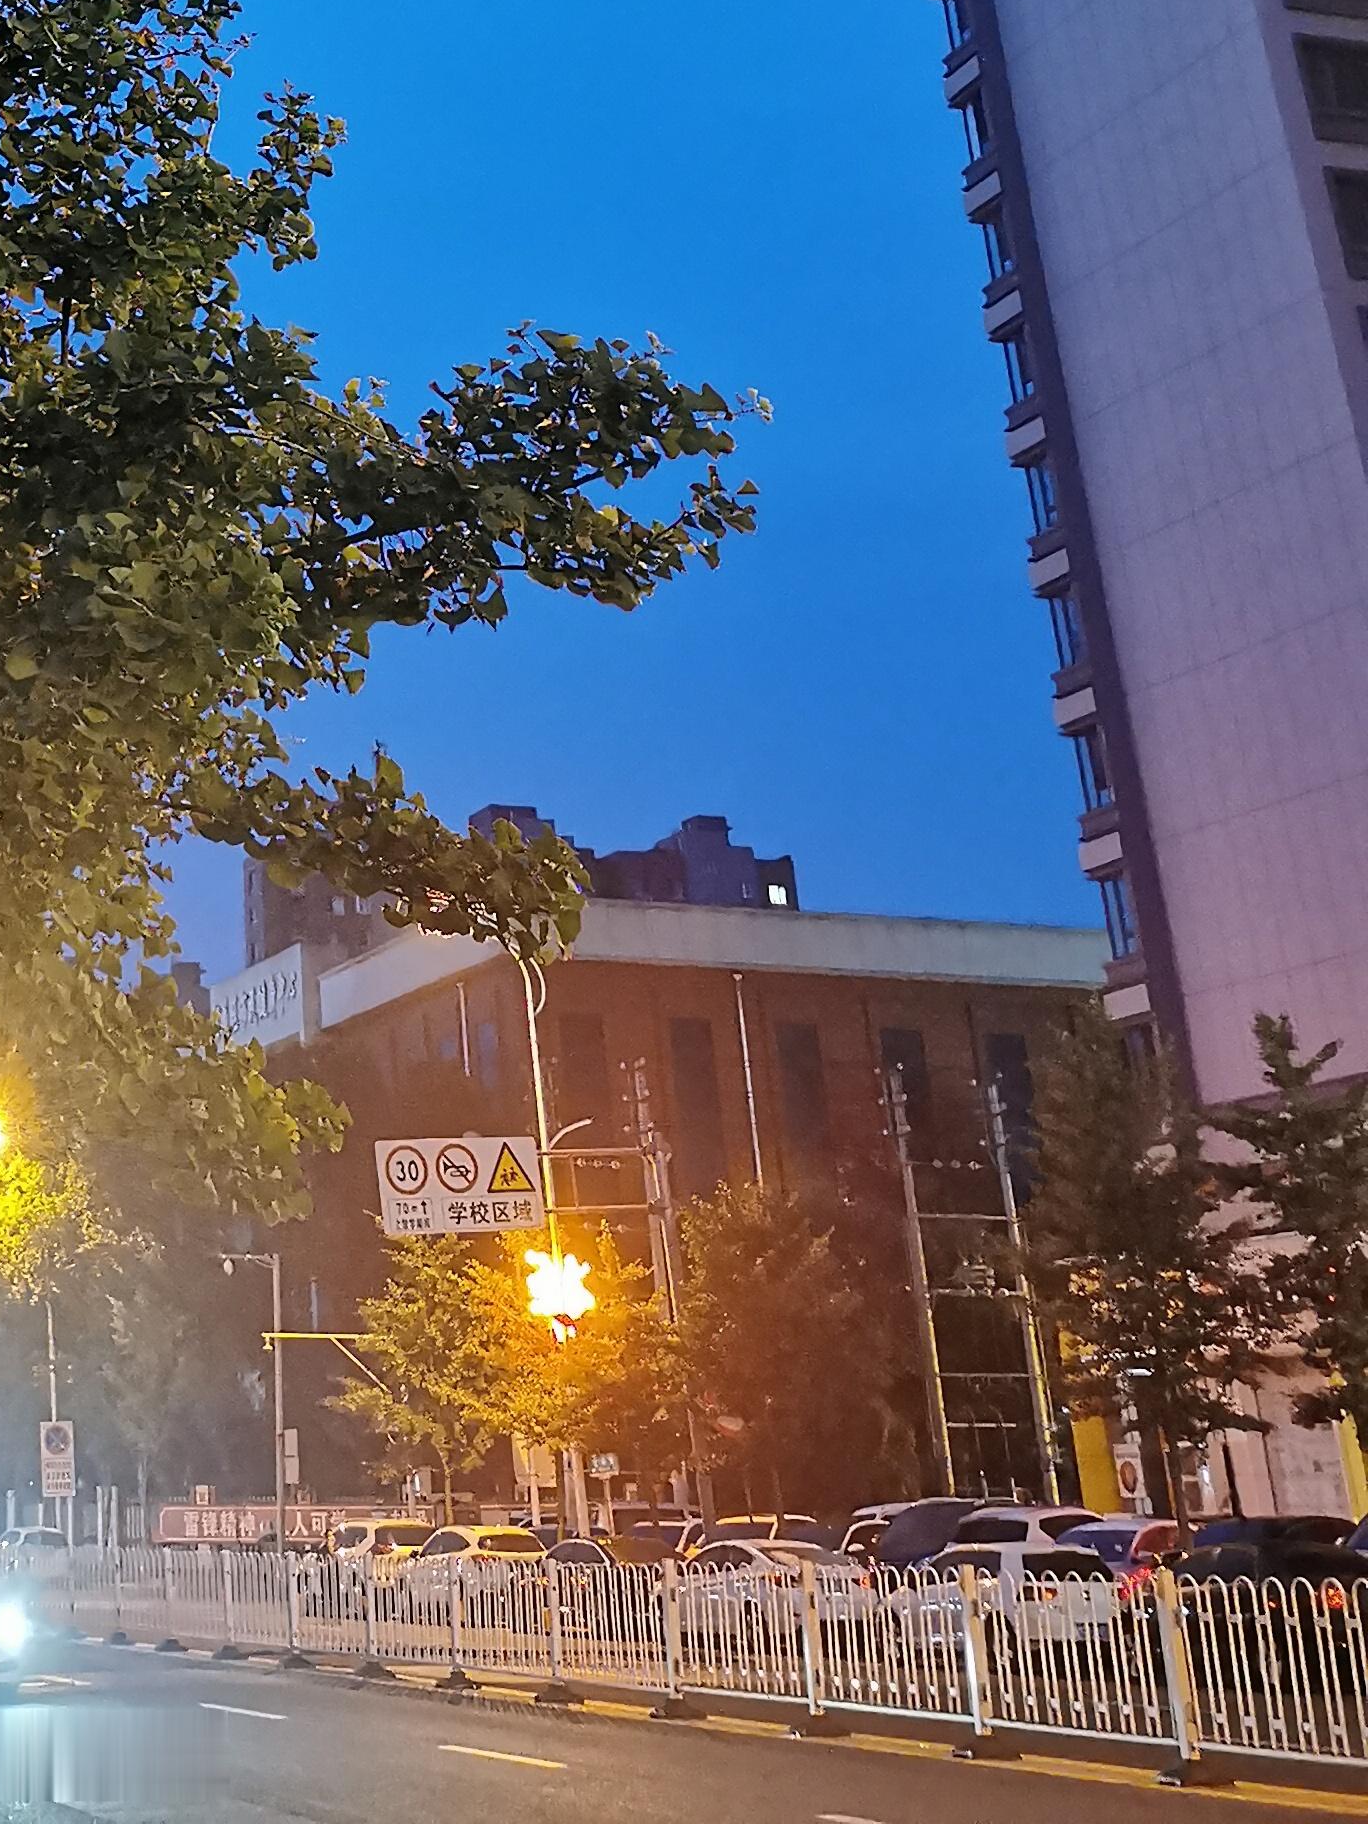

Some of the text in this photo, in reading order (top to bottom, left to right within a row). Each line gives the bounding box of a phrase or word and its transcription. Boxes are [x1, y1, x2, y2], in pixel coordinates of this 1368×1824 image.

[395, 1160, 419, 1182] 30
[448, 1200, 533, 1225] 学校区域
[183, 1511, 256, 1537] 雷锋精神
